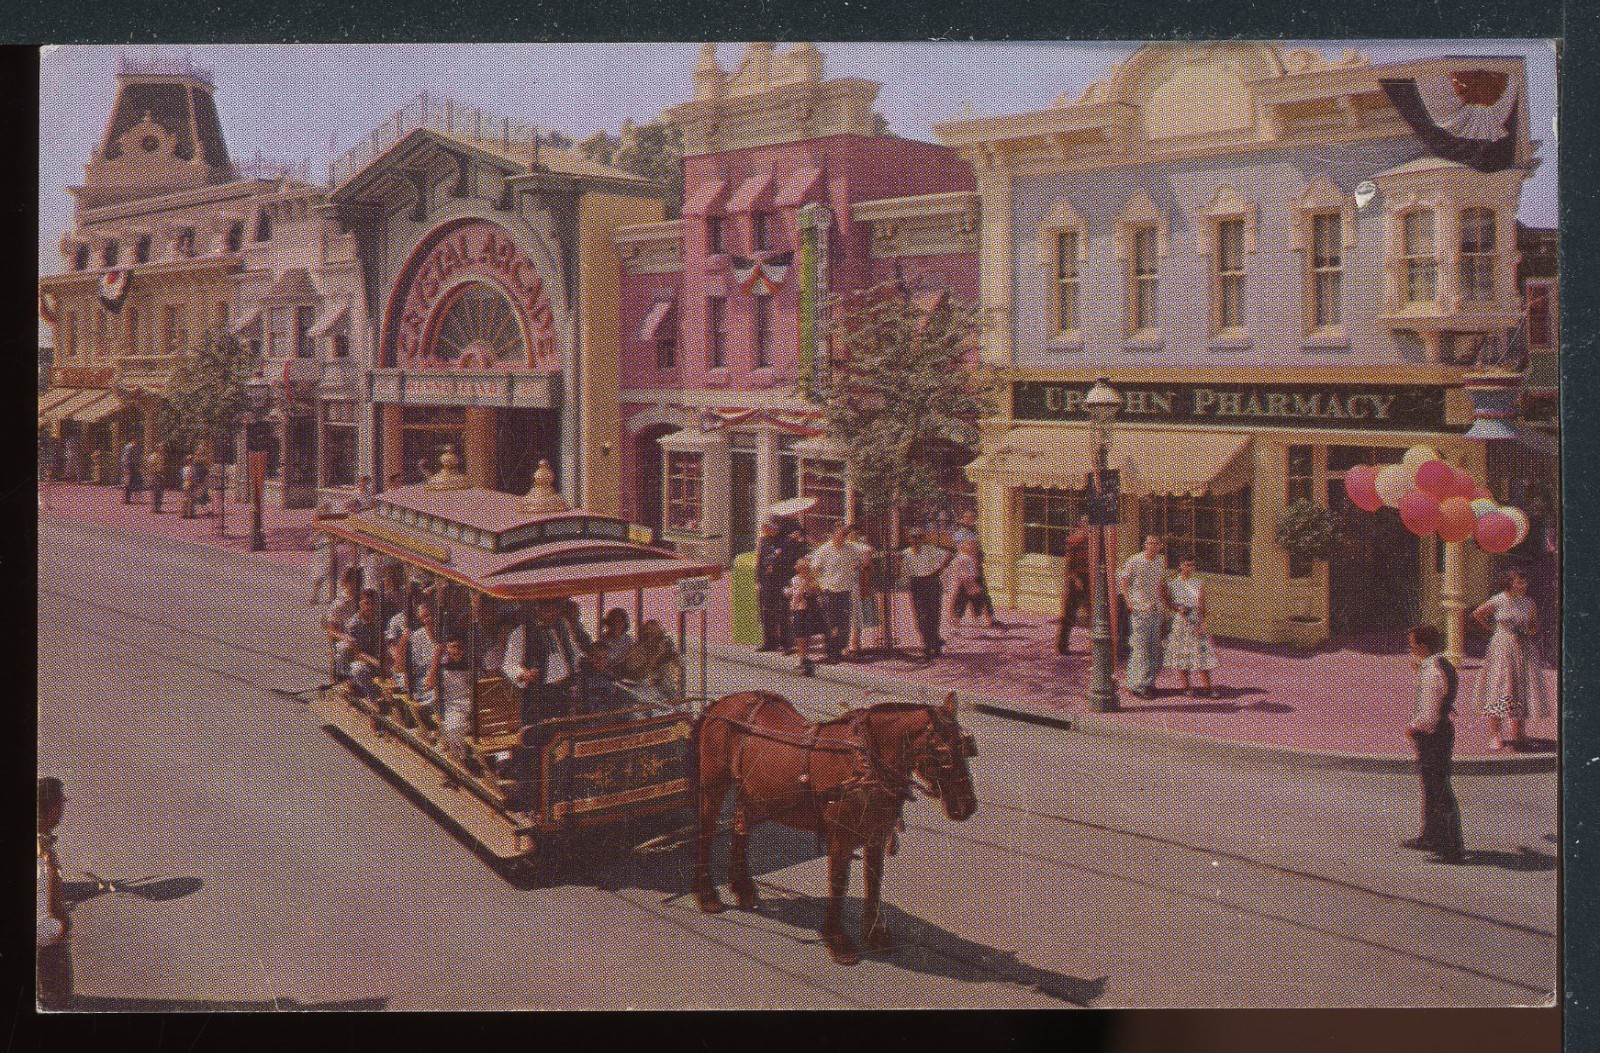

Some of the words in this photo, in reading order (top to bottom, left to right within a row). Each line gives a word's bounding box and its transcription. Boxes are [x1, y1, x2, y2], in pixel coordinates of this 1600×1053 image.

[400, 234, 474, 358] CRYSTAL
[478, 232, 557, 361] ARCADE
[1044, 387, 1173, 414] UPHN
[1193, 388, 1396, 419] PHARMACY
